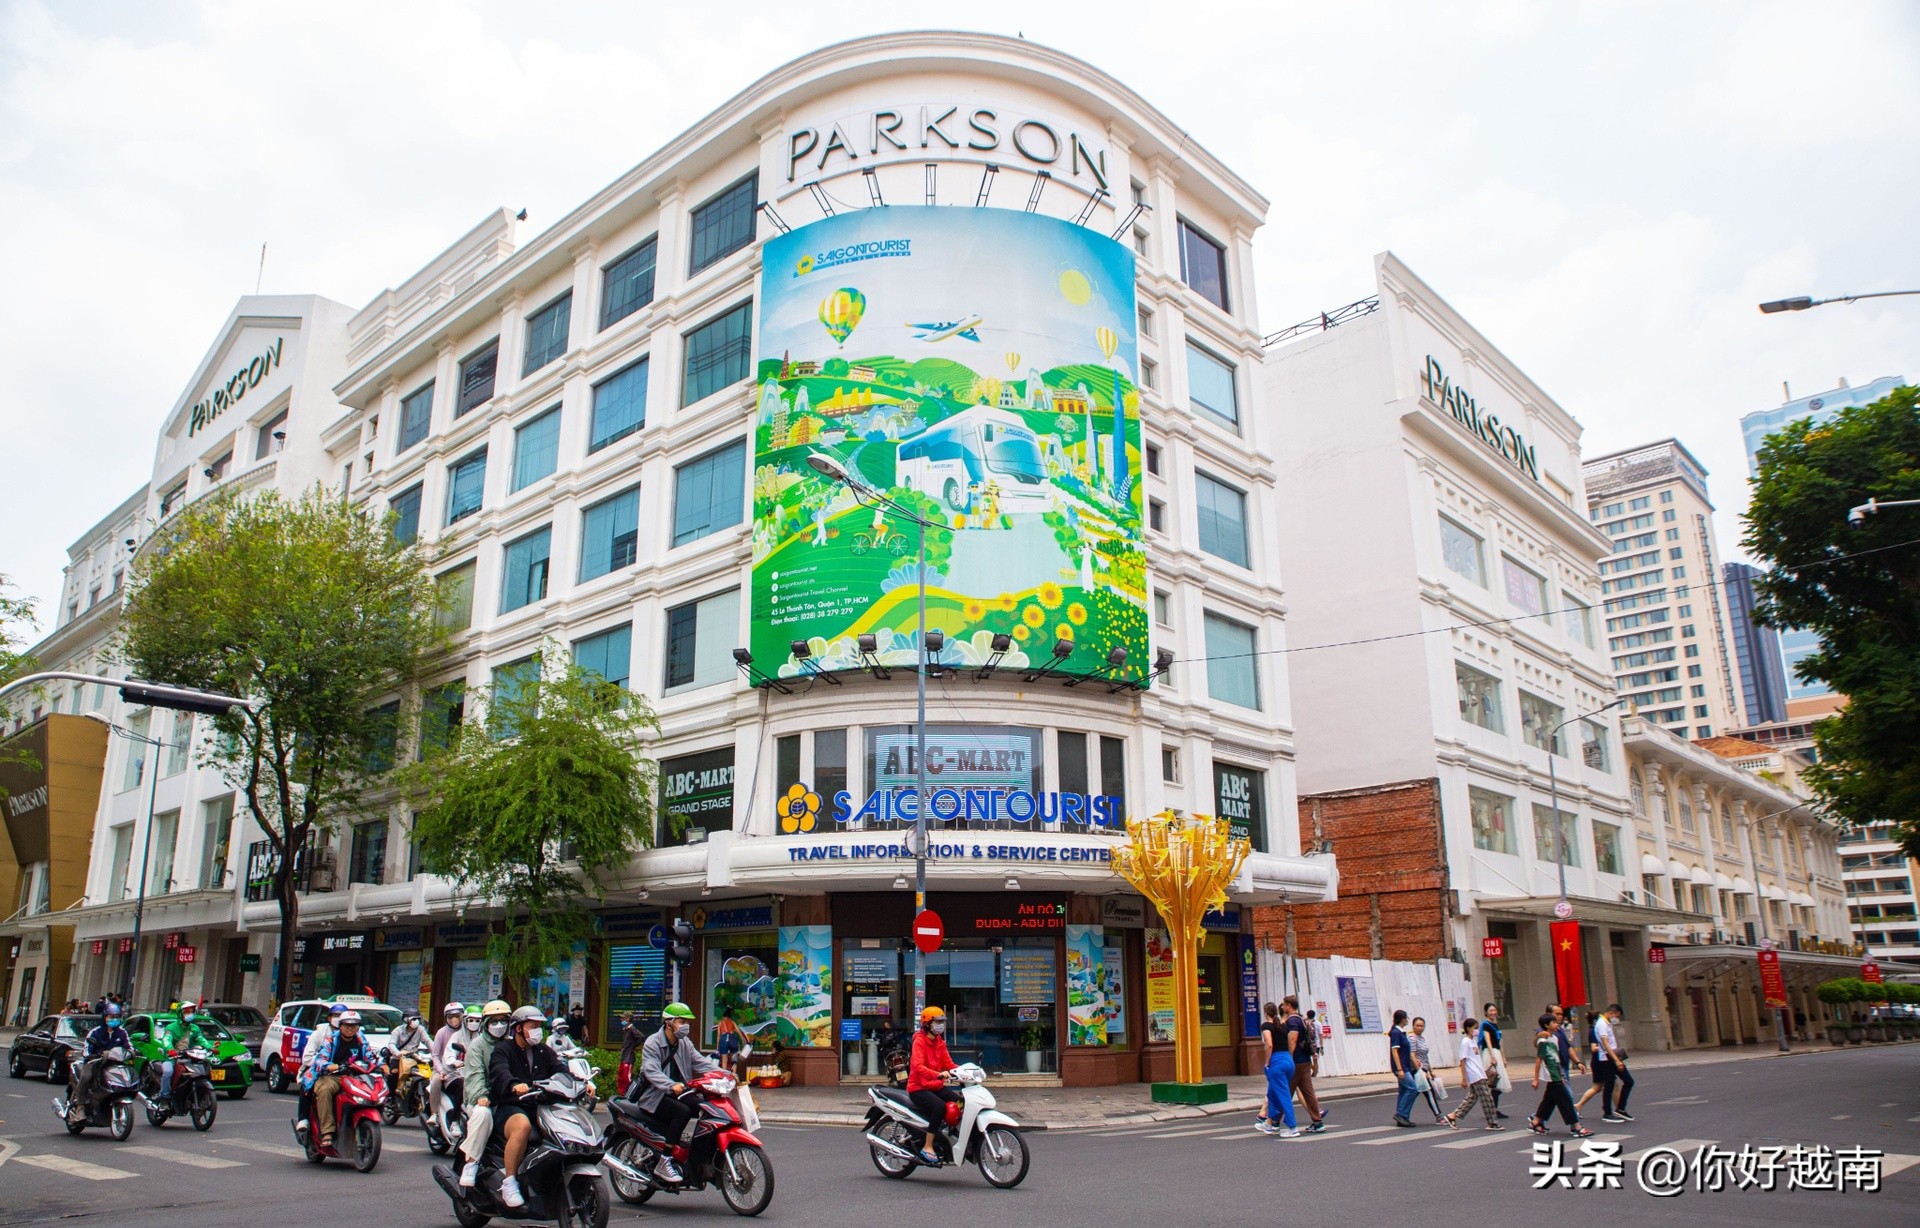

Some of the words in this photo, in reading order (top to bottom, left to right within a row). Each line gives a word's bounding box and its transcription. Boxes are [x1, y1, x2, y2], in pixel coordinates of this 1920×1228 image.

[787, 106, 1110, 190] PARKSON
[817, 239, 911, 264] SAIGONTOURIST
[188, 336, 283, 438] PARKSON
[1426, 354, 1538, 482] PARKSON
[810, 588, 825, 596] Travel
[826, 585, 849, 593] Channel
[817, 610, 825, 618] 38
[827, 609, 839, 617] 279
[841, 607, 854, 615] 279
[665, 765, 735, 797] ABC-MART
[1221, 772, 1250, 802] ABC
[668, 801, 700, 815] GRAND
[700, 796, 732, 811] STAGE
[832, 788, 1122, 828] SAIGONTOURIST
[1221, 798, 1251, 819] MART
[1229, 825, 1249, 837] RAND
[788, 845, 848, 862] TRAVEL
[971, 844, 983, 858] &
[987, 845, 1057, 860] SERVICE
[179, 947, 193, 955] UNI
[179, 954, 194, 962] QLO
[1485, 948, 1501, 956] QLO
